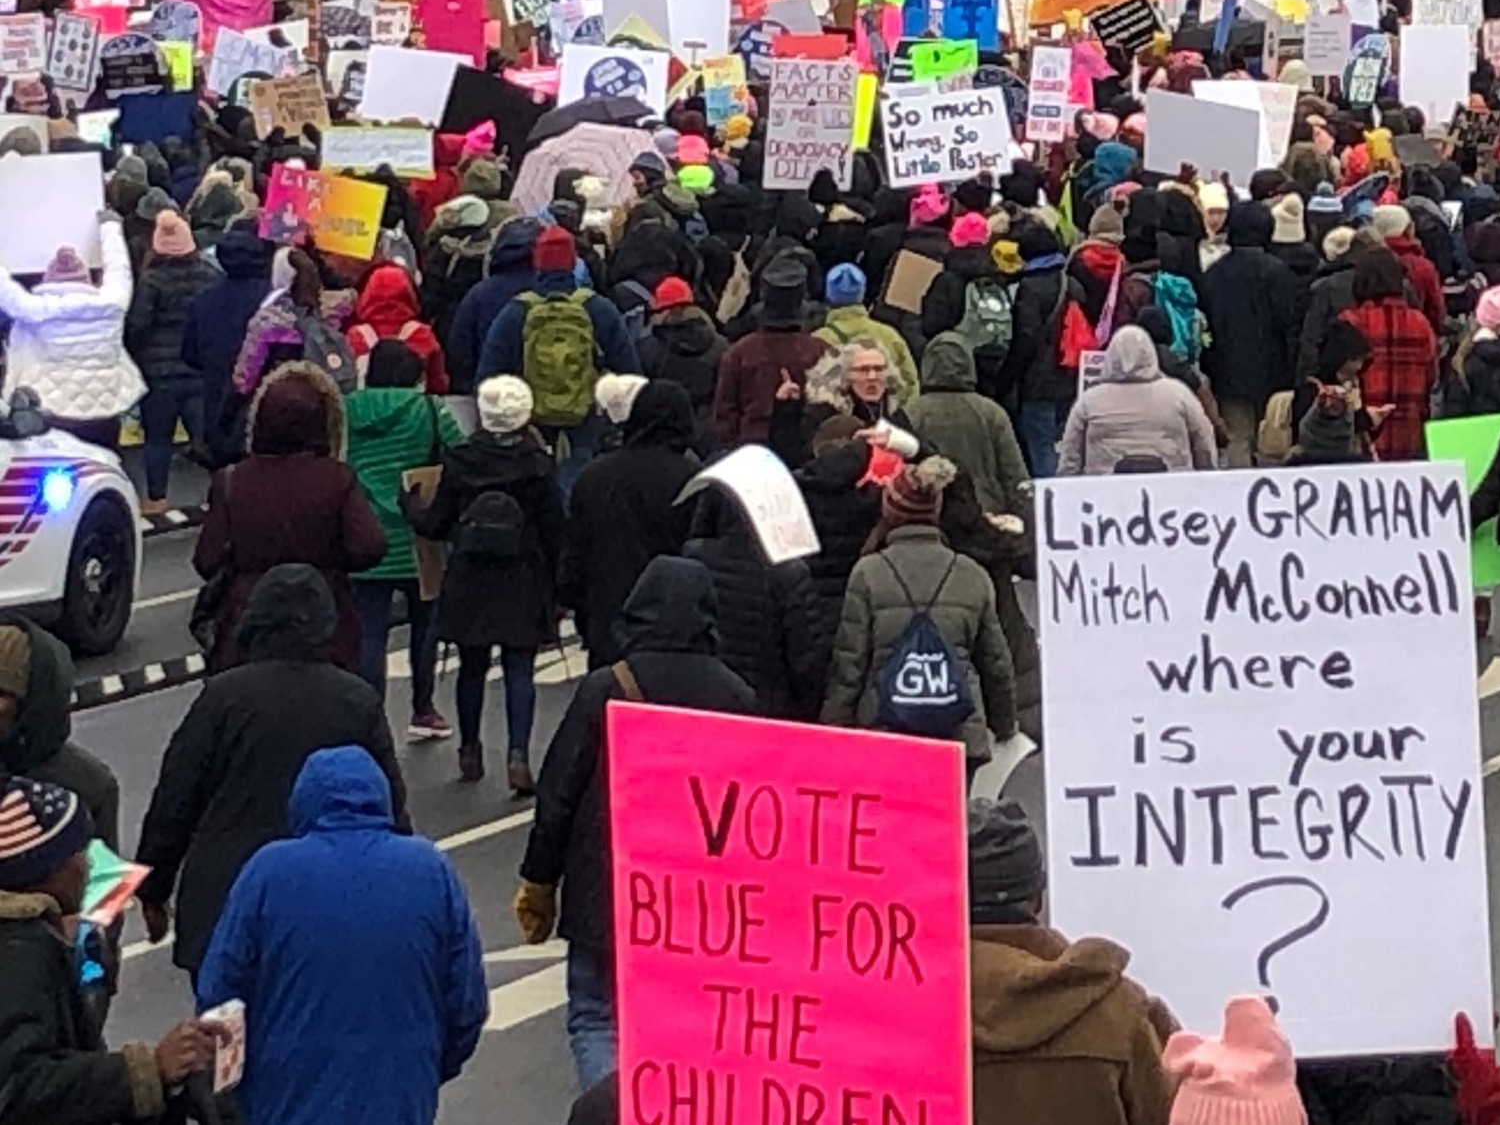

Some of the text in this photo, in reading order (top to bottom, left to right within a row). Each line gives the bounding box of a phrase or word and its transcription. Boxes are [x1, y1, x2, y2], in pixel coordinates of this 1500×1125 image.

[771, 82, 851, 102] MATTER
[776, 62, 852, 84] FACTS
[887, 95, 994, 128] So much
[952, 123, 979, 146] So
[949, 146, 1003, 172] Poster
[1043, 476, 1467, 567] Lindsey GRAHAM
[1051, 551, 1461, 626] Mitch McConnell
[1147, 634, 1355, 692] where
[1132, 716, 1426, 786] is your
[688, 775, 886, 875] VOTE
[1065, 774, 1472, 867] INTEGRITY
[628, 870, 925, 986] BLUE FOR
[1221, 875, 1331, 1015] ?
[702, 982, 823, 1069] THE
